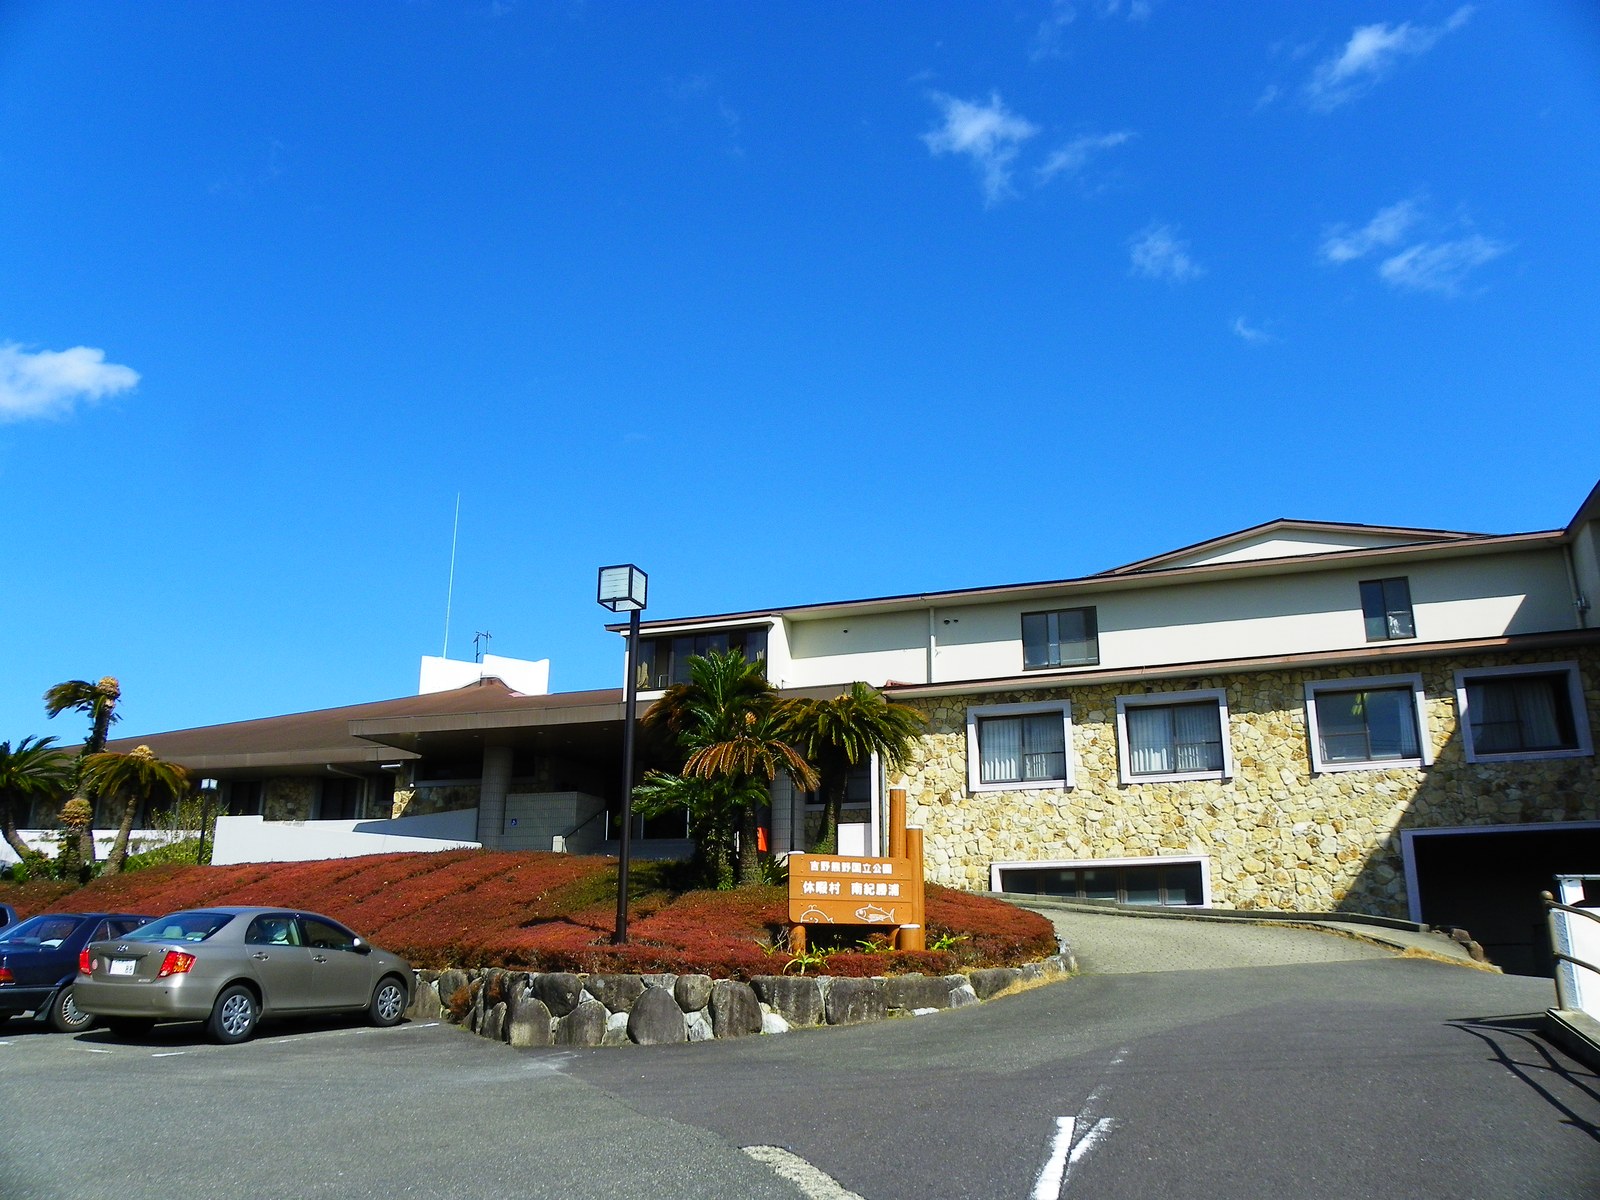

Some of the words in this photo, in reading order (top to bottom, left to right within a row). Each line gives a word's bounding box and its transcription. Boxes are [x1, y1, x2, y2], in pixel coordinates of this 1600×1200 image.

[810, 861, 892, 874] 吉野熊野国立公園
[803, 881, 840, 894] 休暇村
[851, 882, 899, 896] 南紀勝浦
